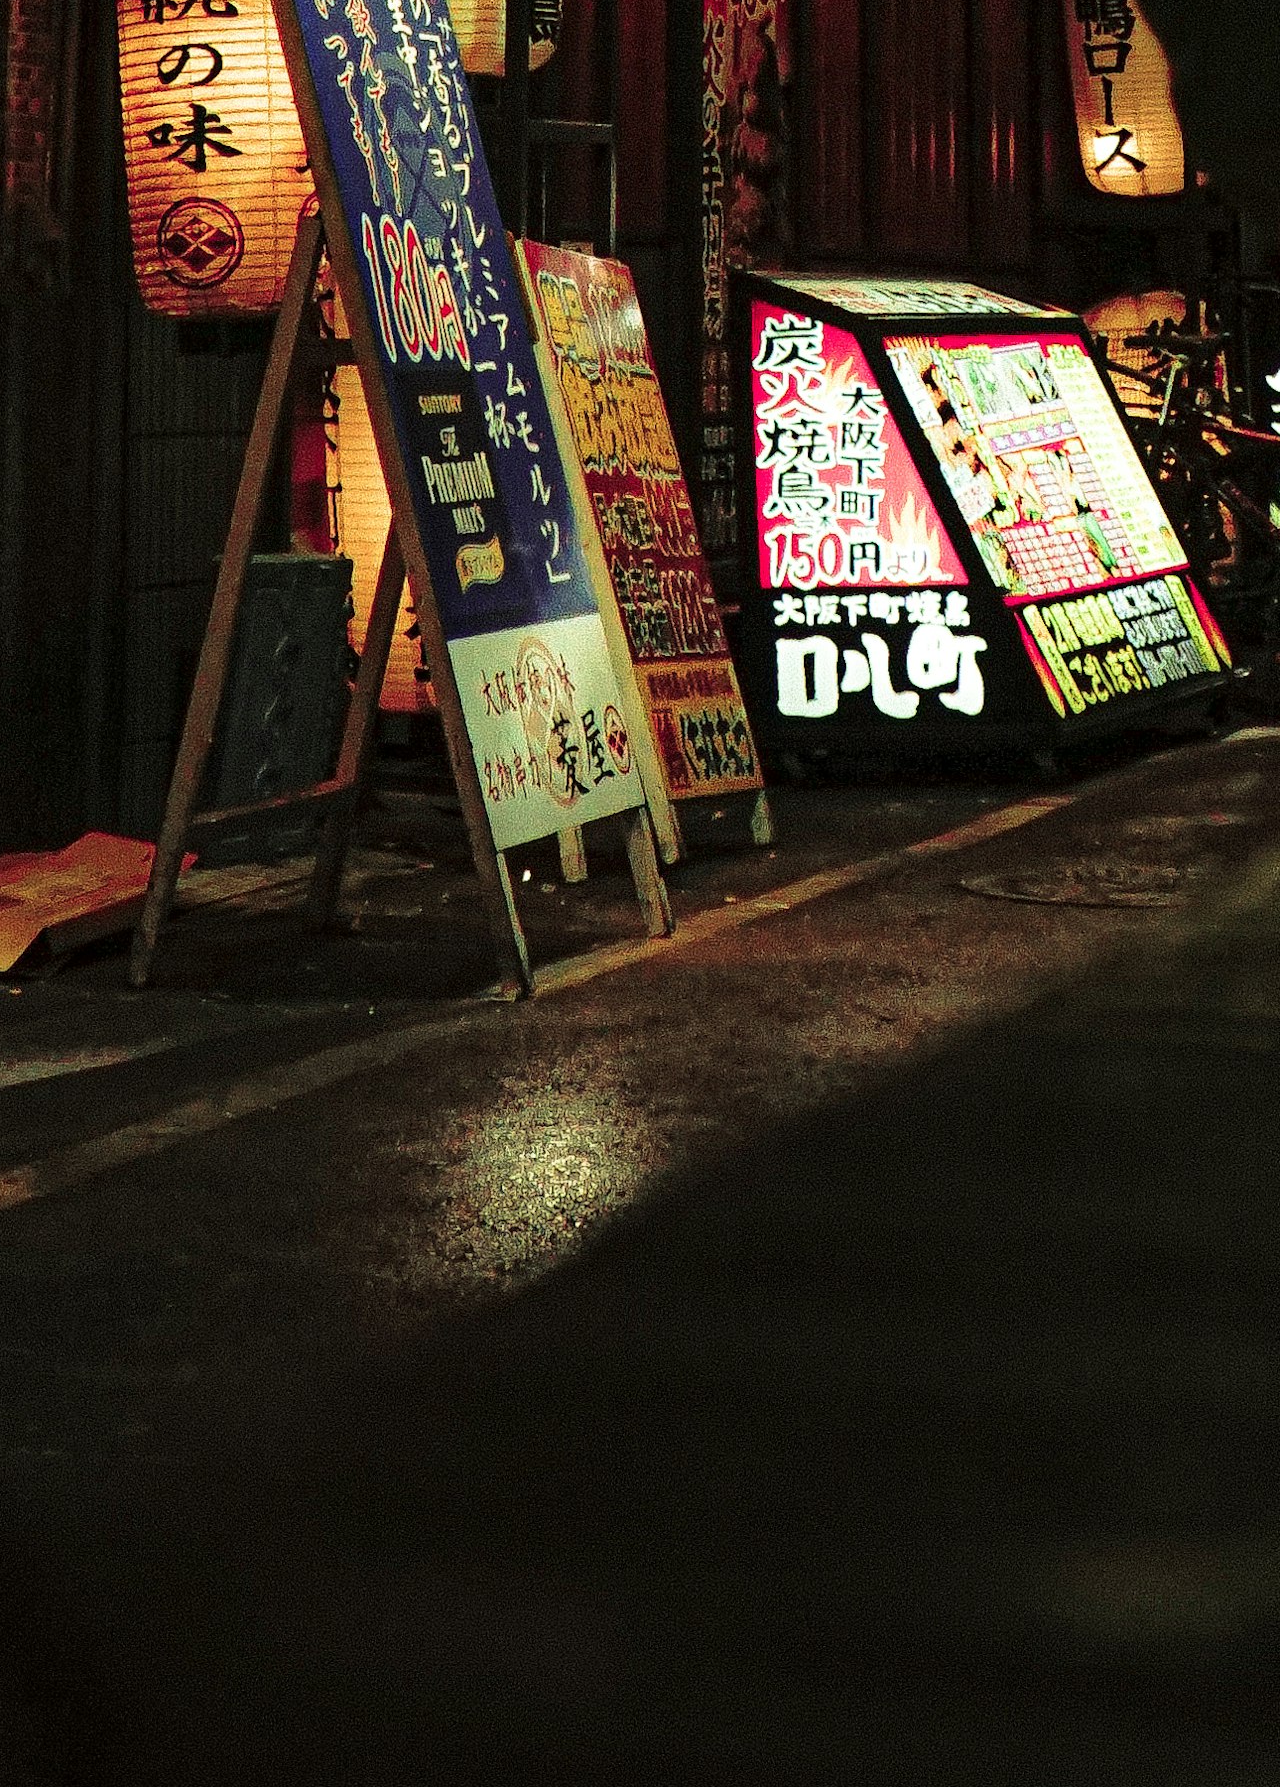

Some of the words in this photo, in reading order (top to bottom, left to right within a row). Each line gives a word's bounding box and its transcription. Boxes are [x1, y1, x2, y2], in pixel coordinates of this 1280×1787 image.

[361, 213, 470, 369] 180円
[417, 393, 462, 415] SUNTORY
[753, 311, 836, 521] 炭火焼鳥
[421, 451, 494, 503] PREMIUM
[841, 384, 890, 523] 大阪下町
[475, 652, 579, 724] 大阪伝統の味
[546, 704, 617, 799] 菱屋
